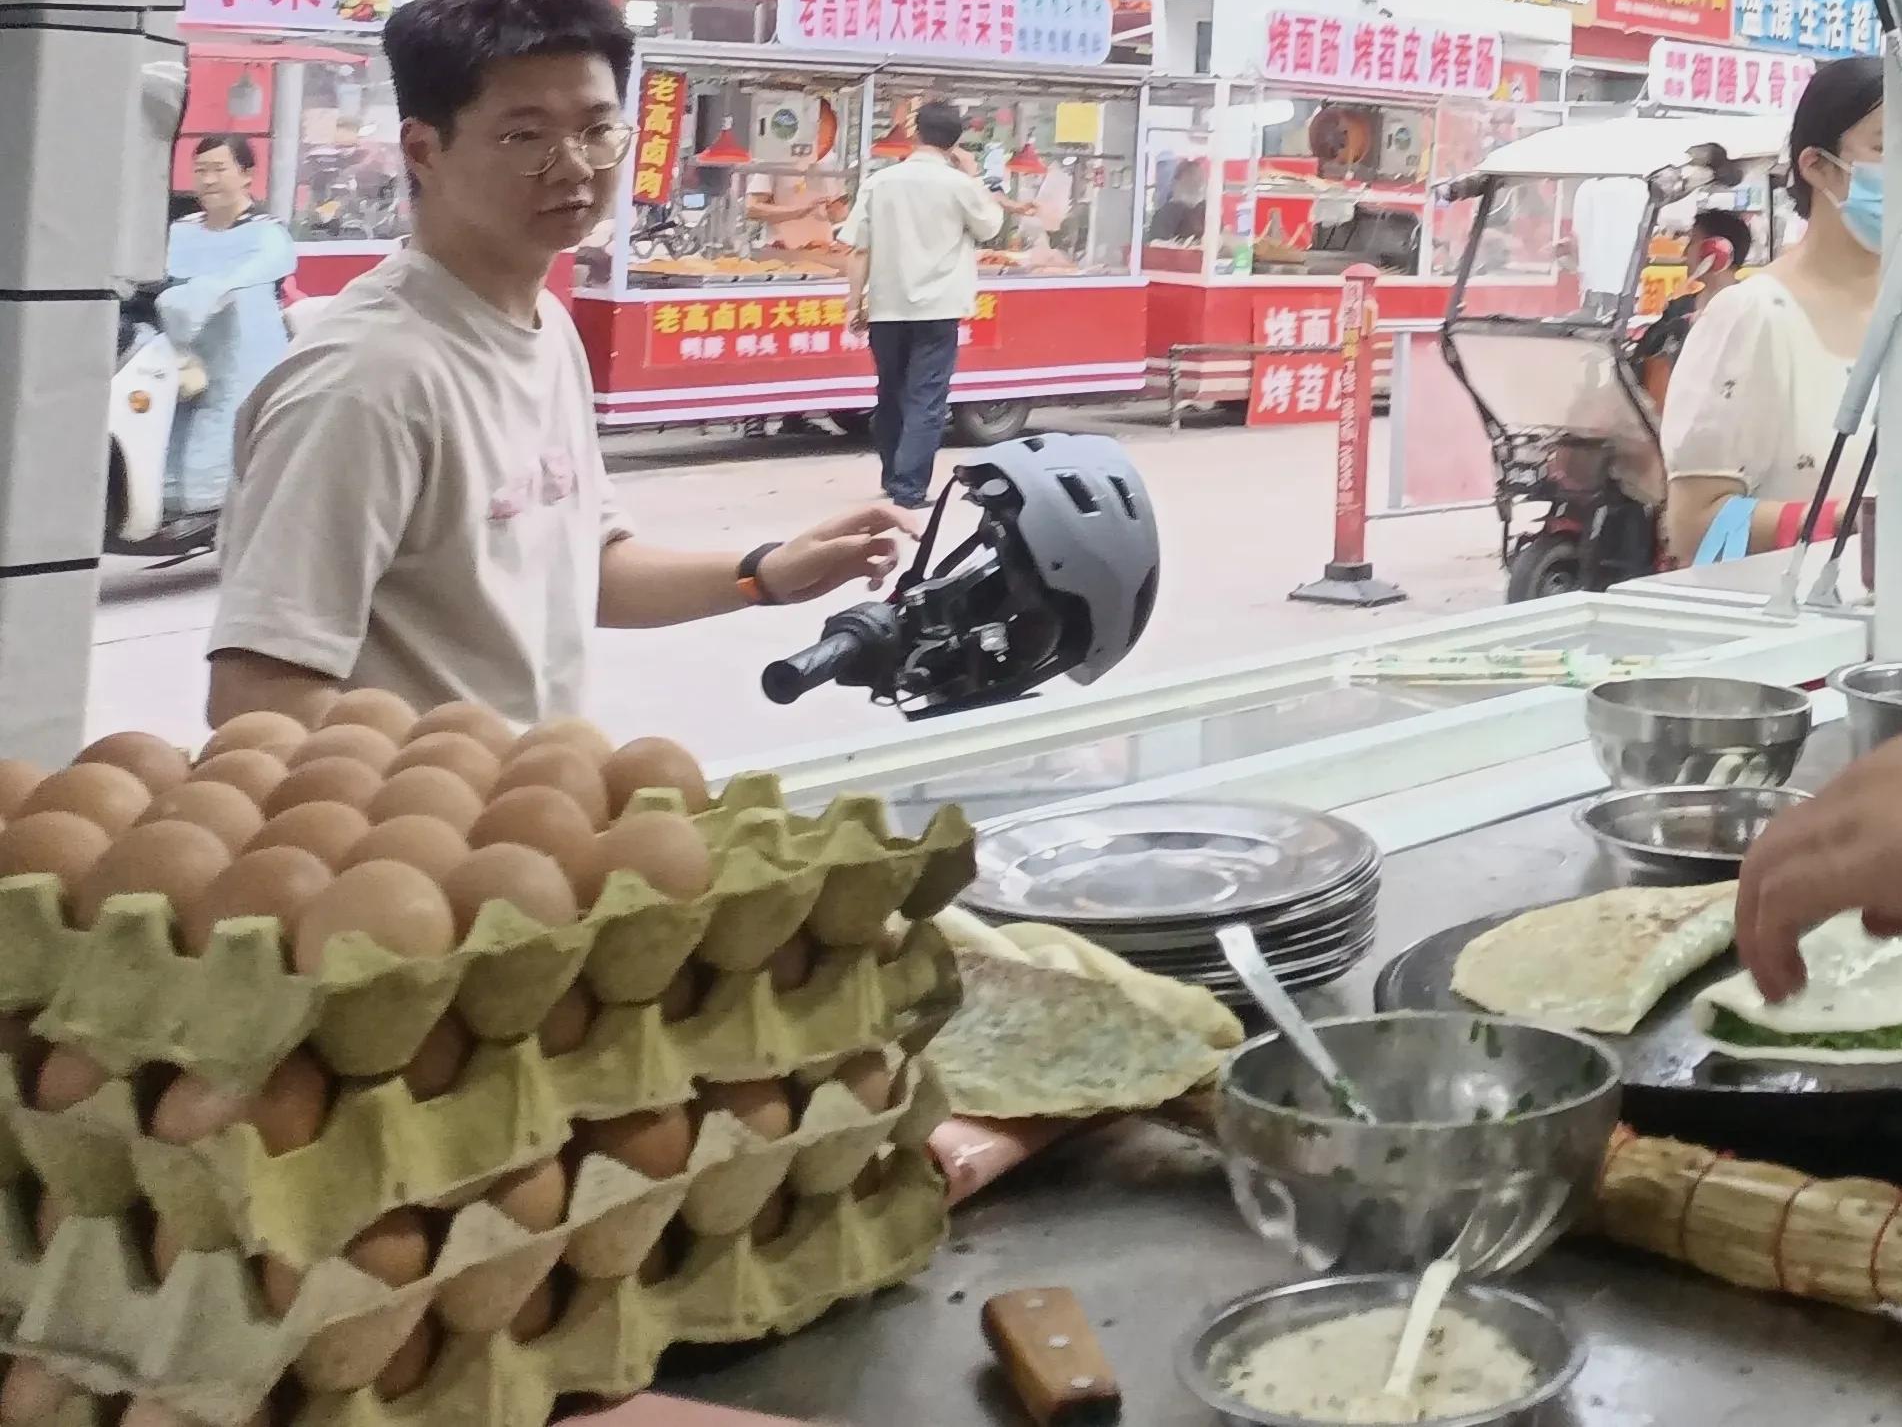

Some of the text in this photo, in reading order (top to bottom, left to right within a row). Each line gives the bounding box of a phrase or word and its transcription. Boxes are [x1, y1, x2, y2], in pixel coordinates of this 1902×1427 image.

[1266, 13, 1342, 76] 烤面筋
[634, 74, 680, 200] 老高卤肉
[653, 300, 763, 335] 老高卤肉
